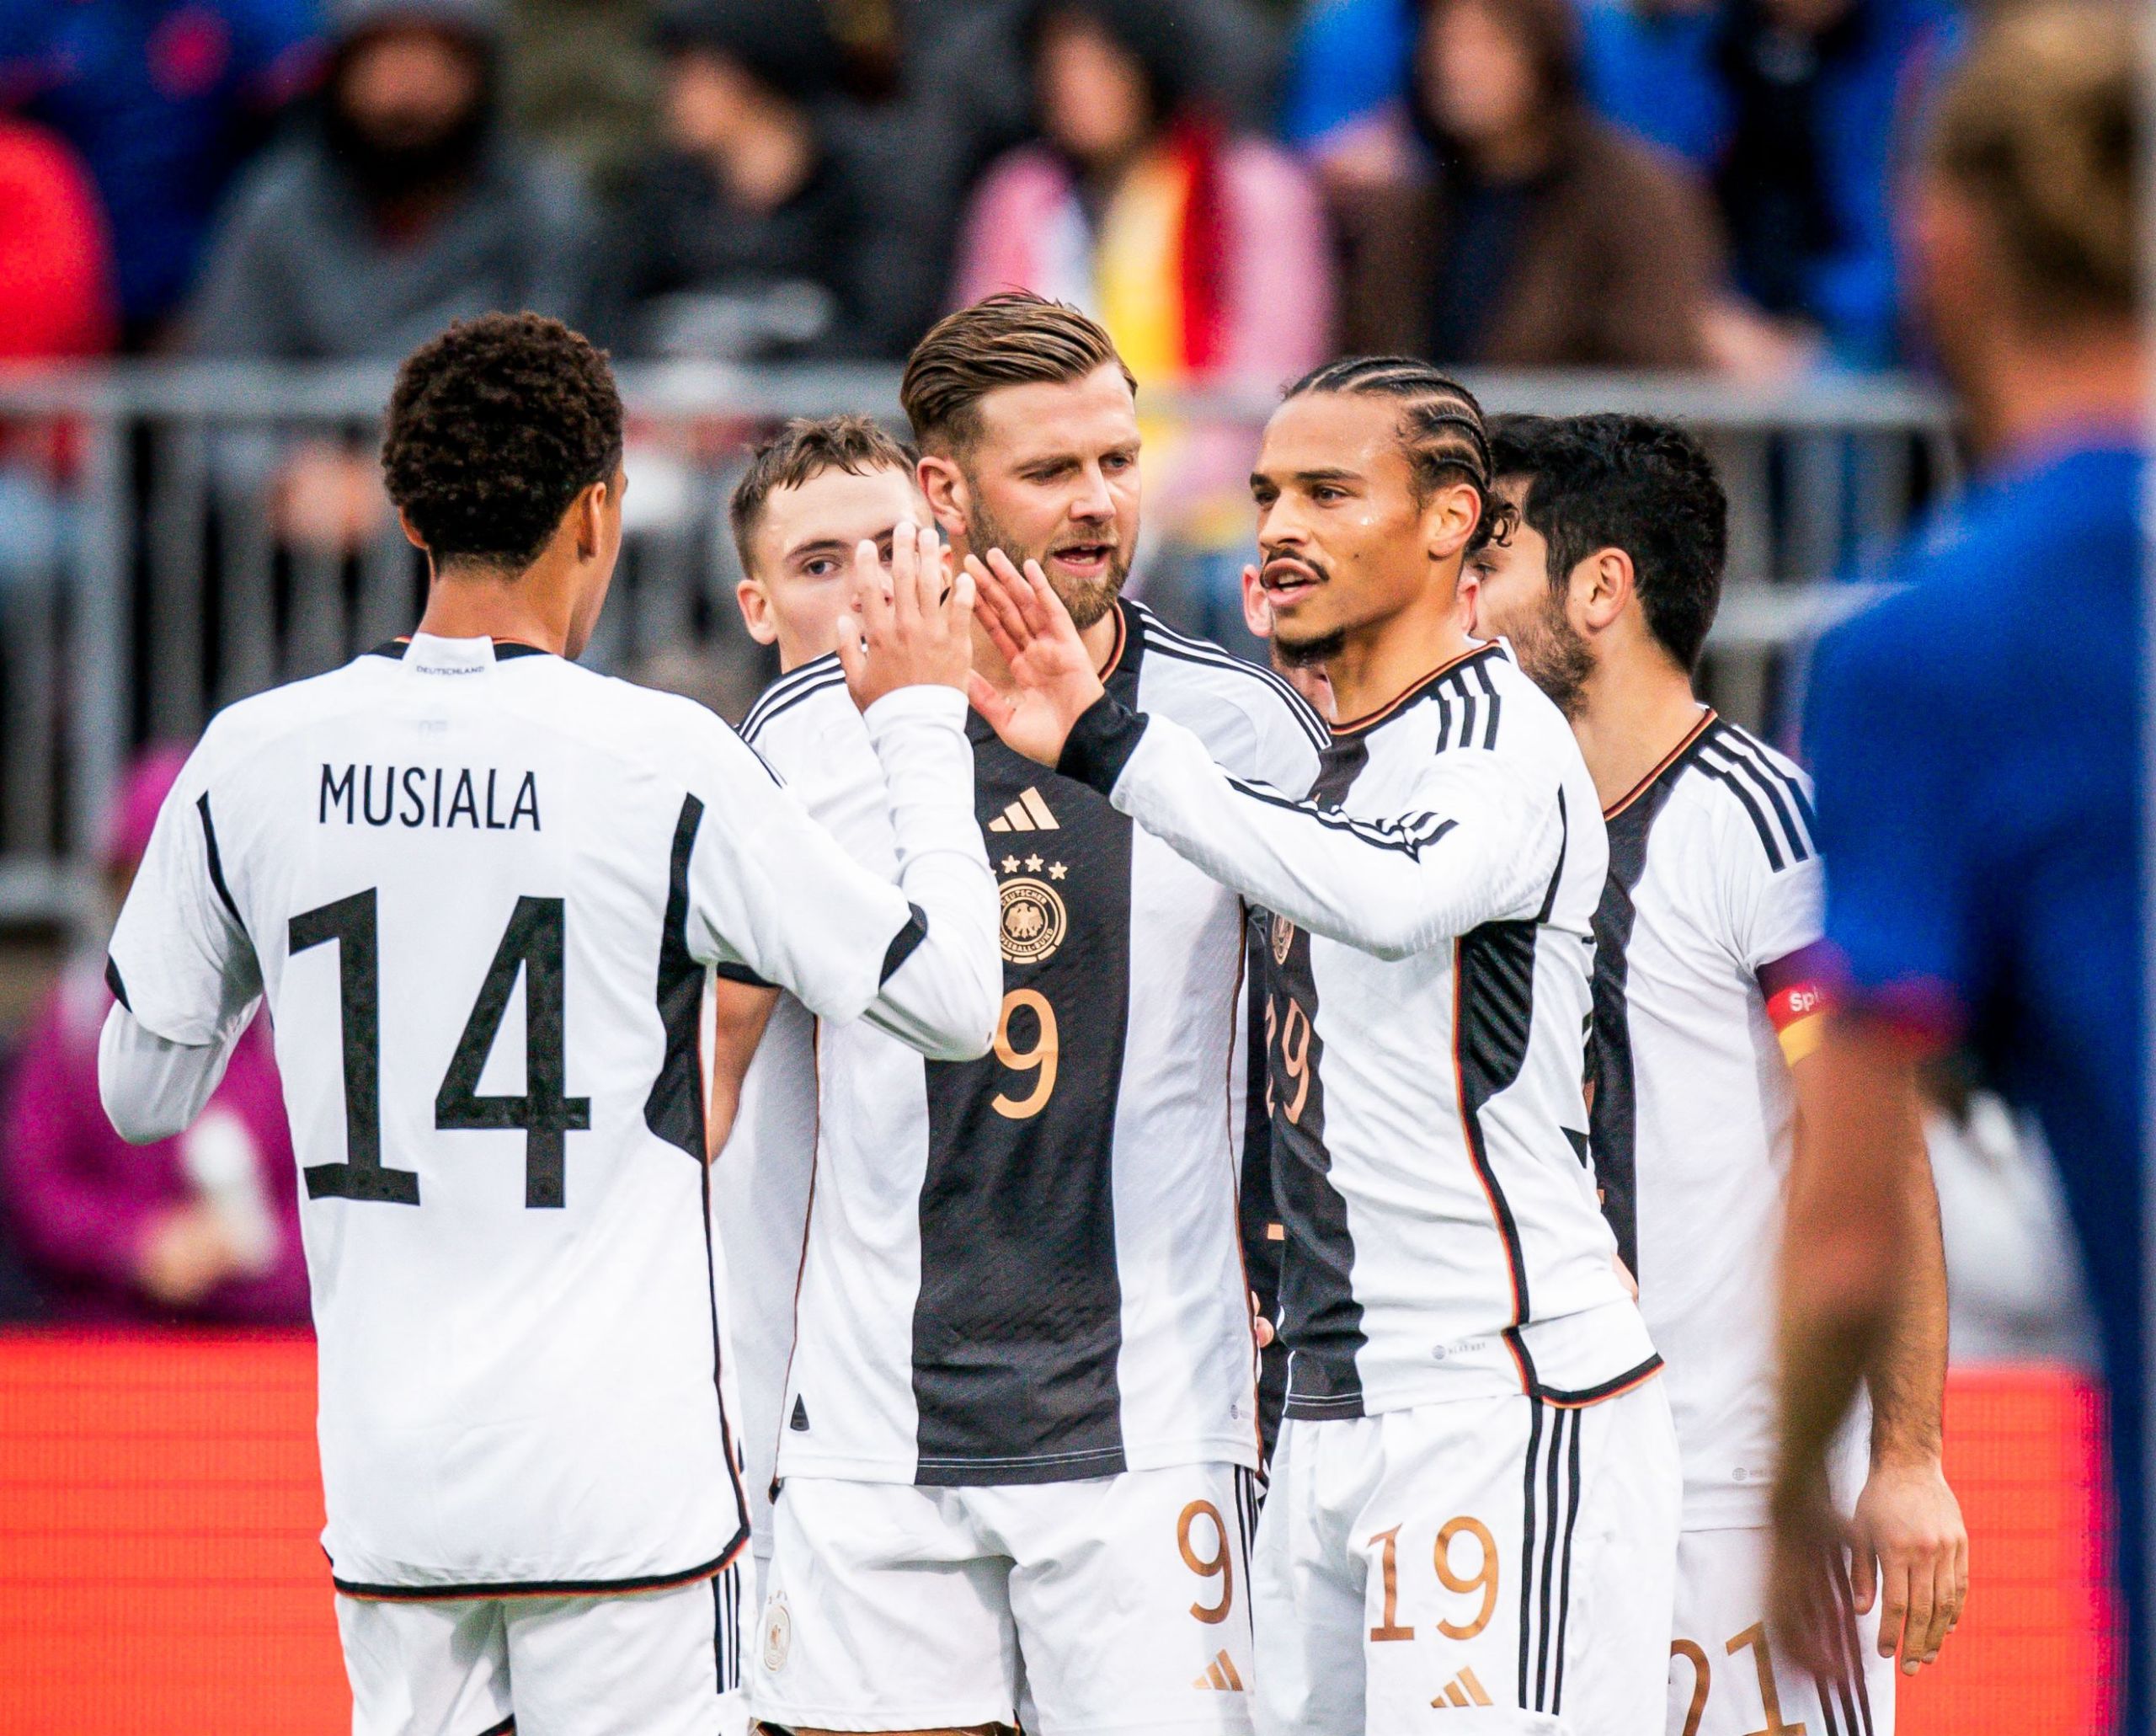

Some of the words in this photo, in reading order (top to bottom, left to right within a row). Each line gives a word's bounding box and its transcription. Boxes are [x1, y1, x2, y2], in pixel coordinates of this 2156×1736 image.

[319, 763, 541, 831] MUSIALA
[288, 886, 590, 1209] 14
[990, 988, 1059, 1119] 9
[1177, 1499, 1232, 1625] 9
[1367, 1515, 1499, 1643] 19
